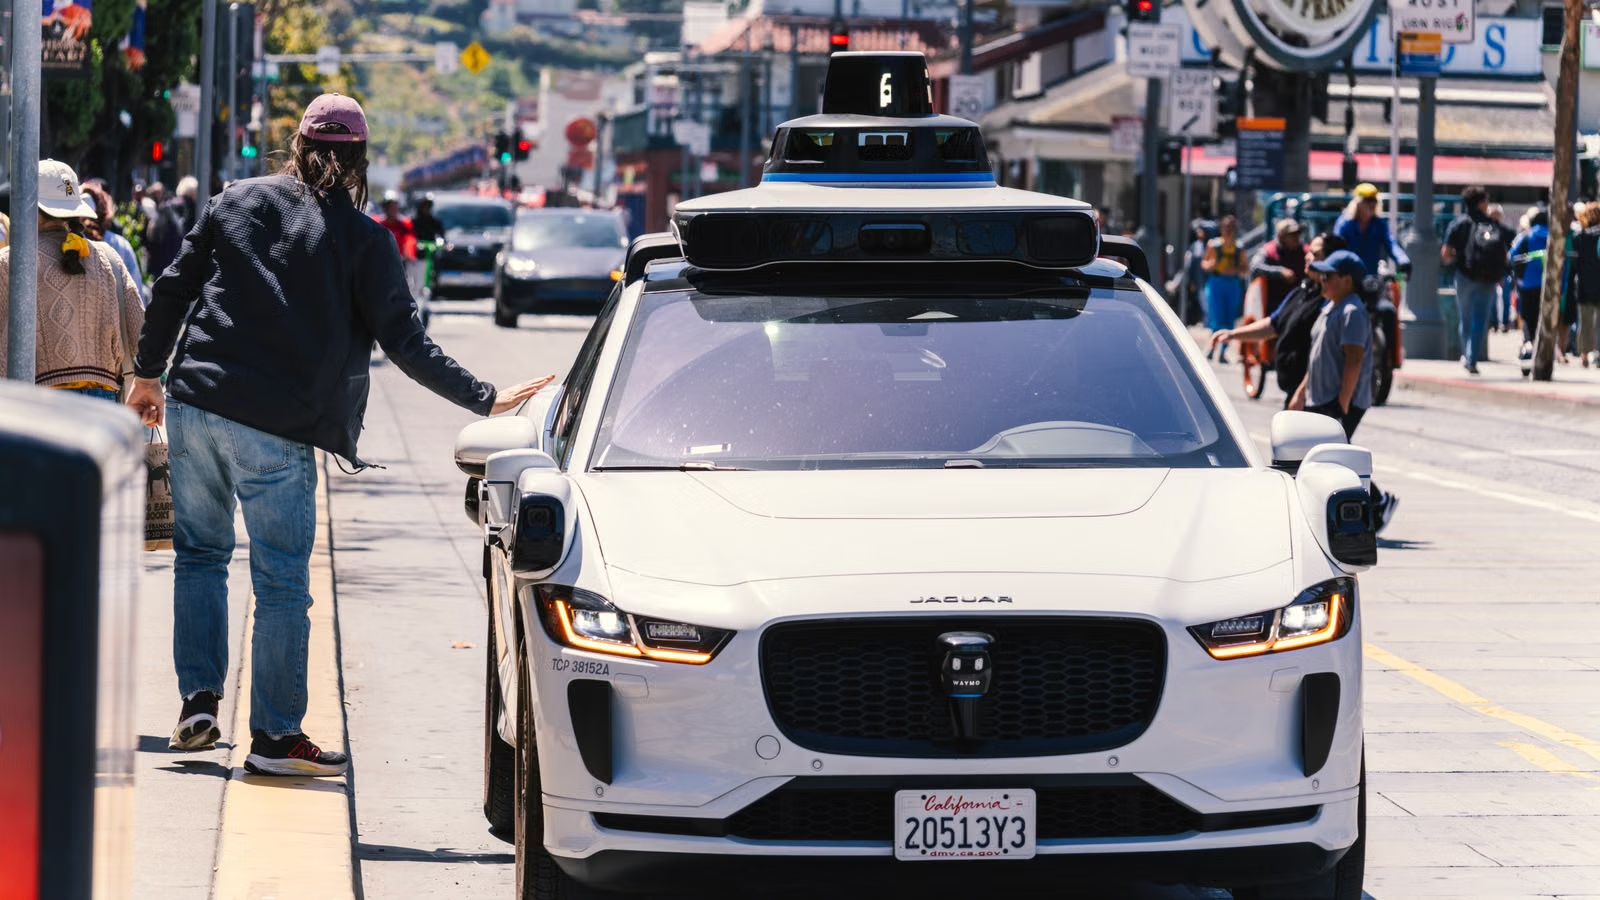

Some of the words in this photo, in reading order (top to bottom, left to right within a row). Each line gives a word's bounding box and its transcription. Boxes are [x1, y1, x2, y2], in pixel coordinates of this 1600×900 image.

[910, 596, 1013, 604] JAGUAR
[552, 658, 570, 671] TCP
[571, 660, 610, 676] 38152A
[924, 795, 1010, 815] California
[905, 816, 1026, 849] 20513Y3
